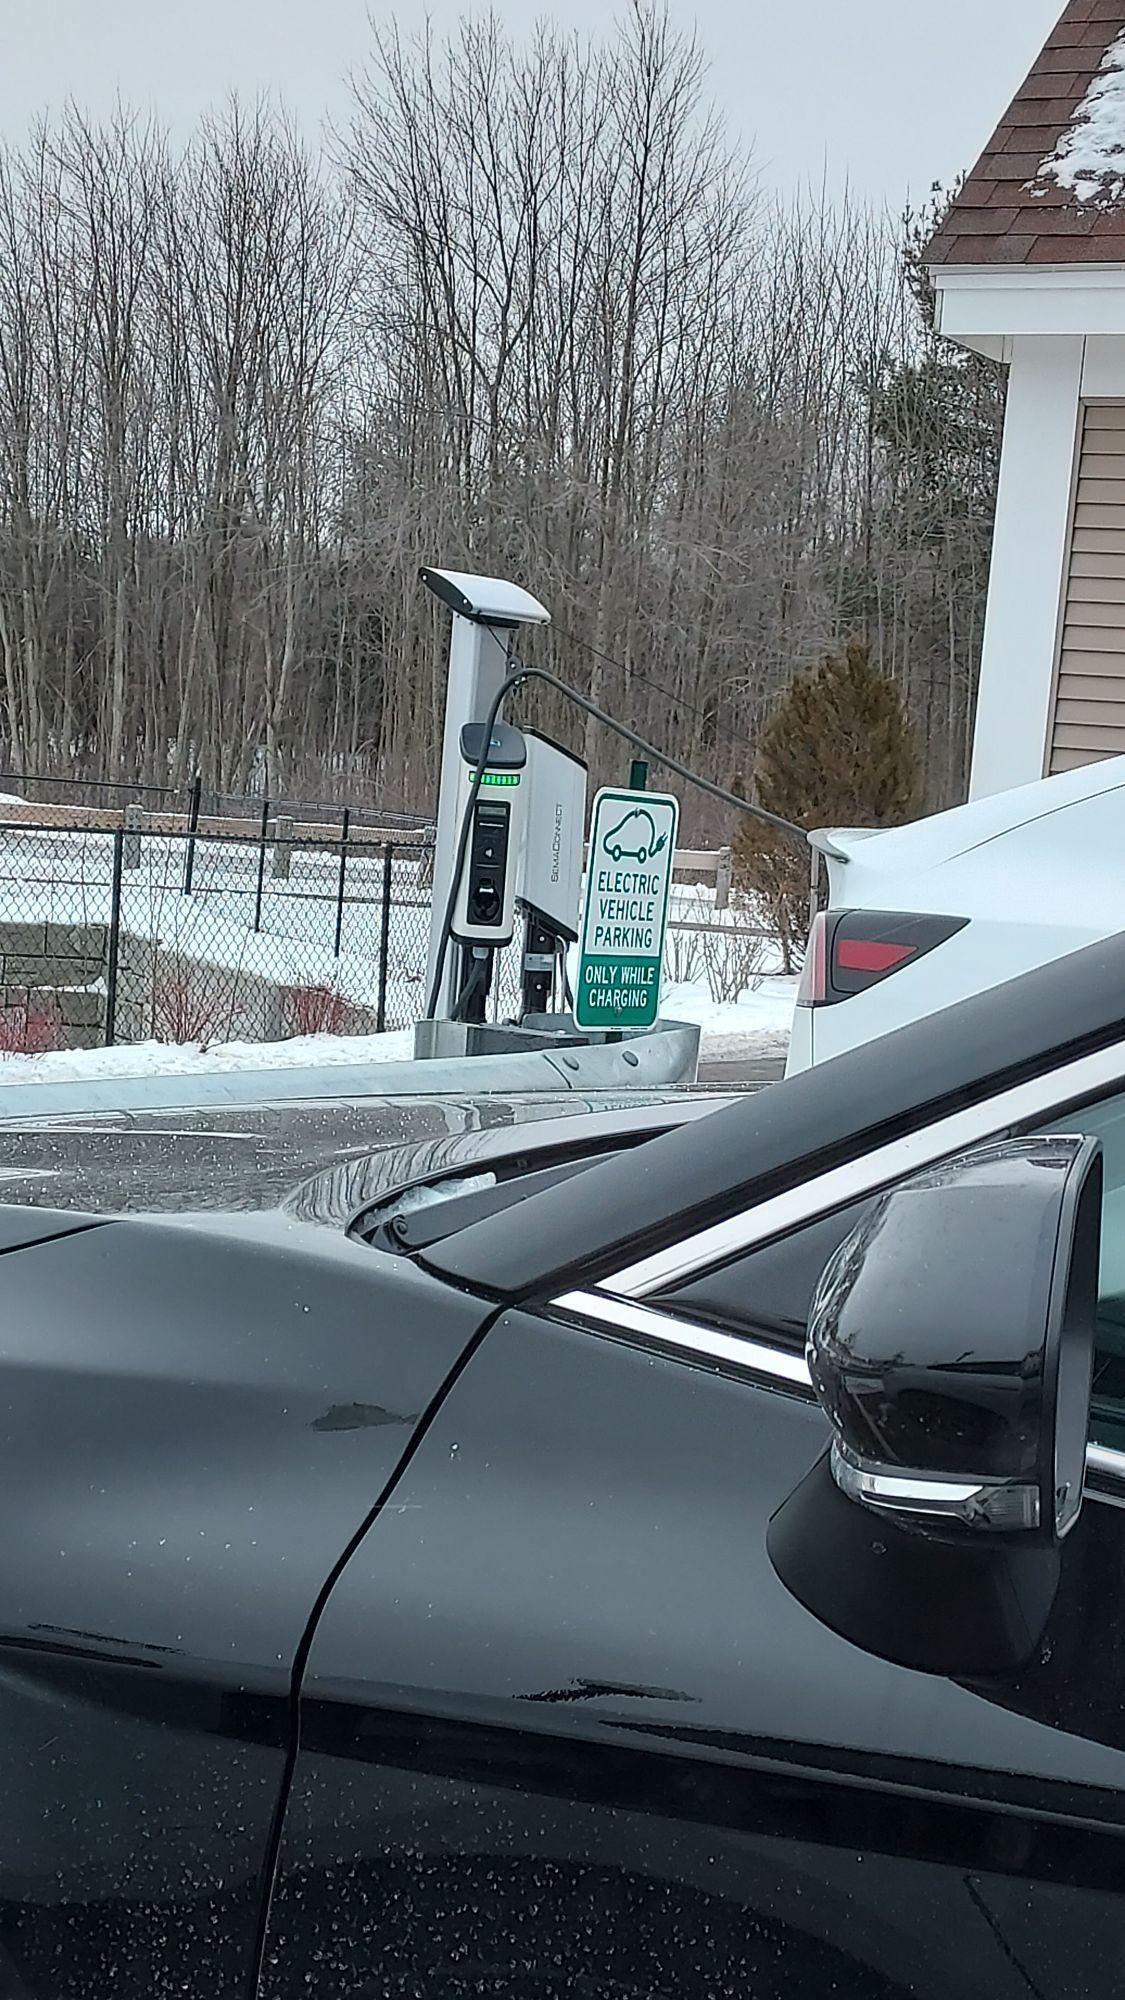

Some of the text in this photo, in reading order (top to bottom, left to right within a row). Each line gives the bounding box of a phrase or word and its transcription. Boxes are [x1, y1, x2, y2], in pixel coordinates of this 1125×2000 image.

[598, 871, 660, 895] ELECTRIC
[600, 899, 655, 921] VEHICLE
[594, 926, 653, 948] PARKING
[585, 965, 655, 985] ONLY WHILE
[589, 989, 647, 1008] CHARGING
